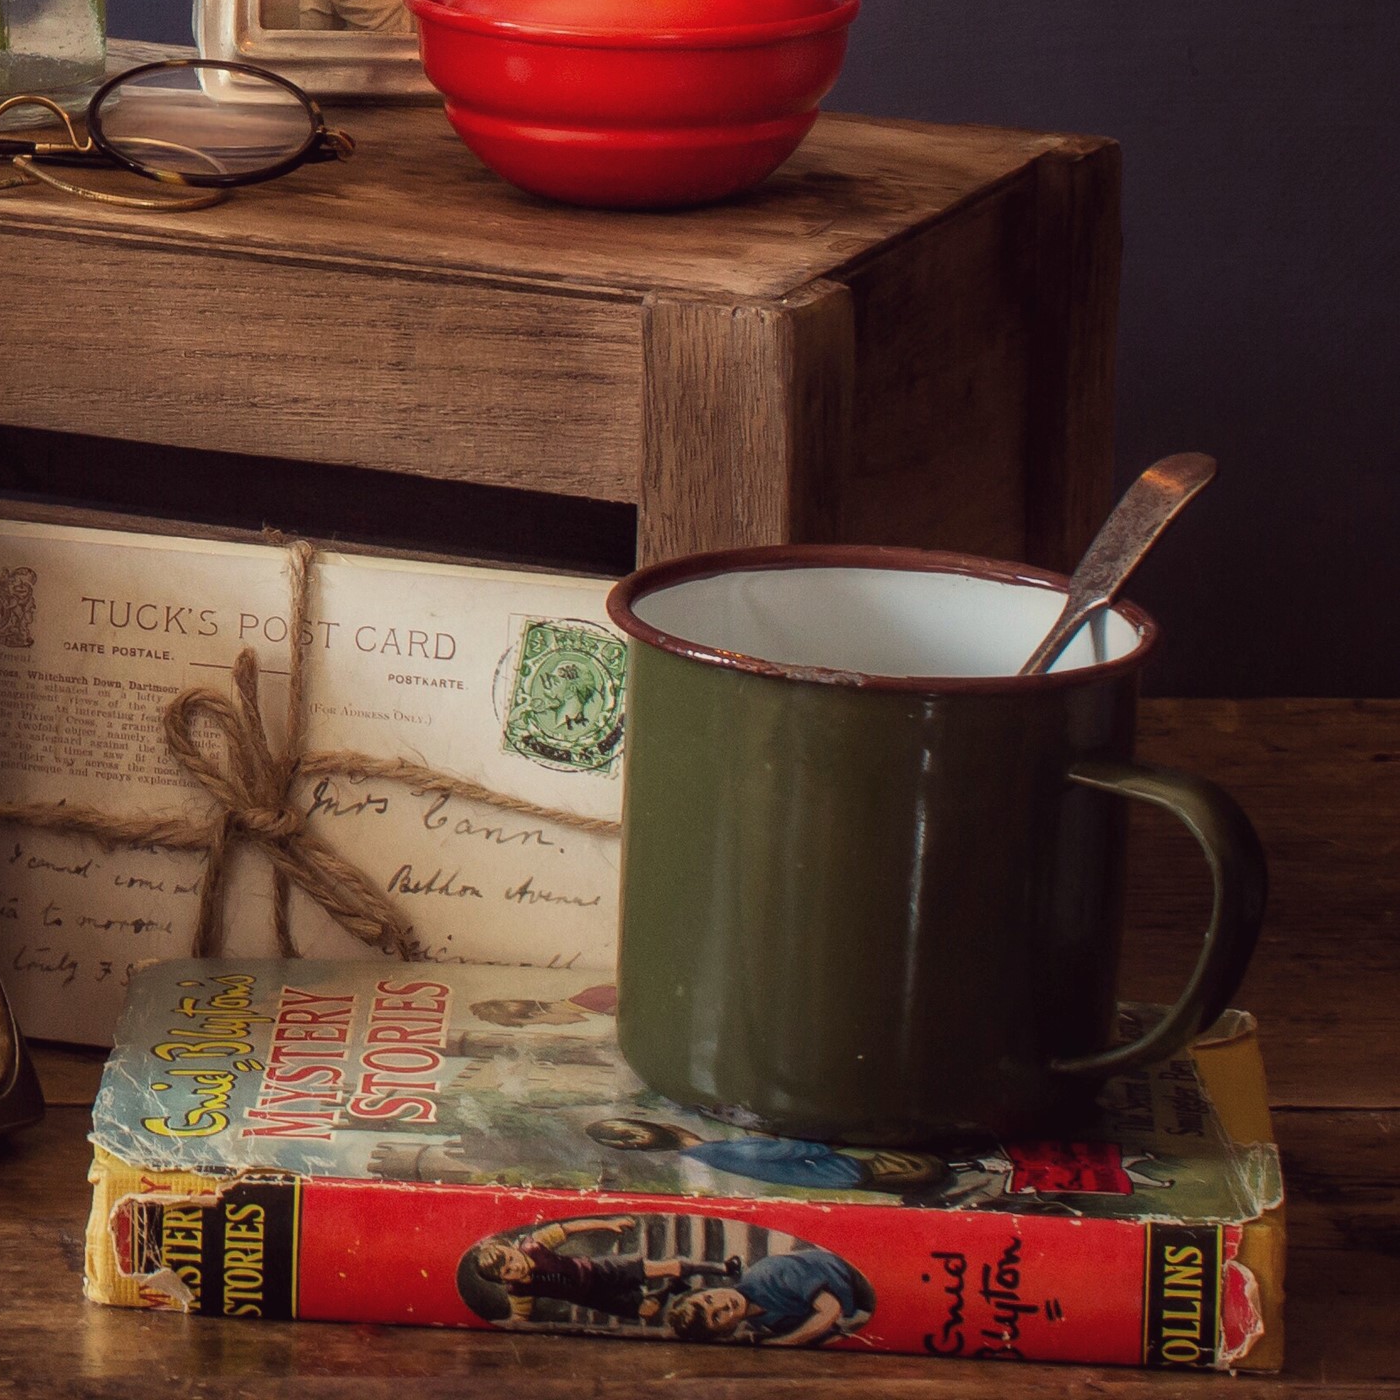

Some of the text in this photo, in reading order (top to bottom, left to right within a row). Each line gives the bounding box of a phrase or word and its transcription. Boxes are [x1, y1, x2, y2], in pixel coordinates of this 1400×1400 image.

[63, 641, 175, 661] CARTE POSTALE.
[81, 596, 457, 661] TUCK'S POST CARD
[27, 669, 87, 686] Whitchurch
[128, 679, 179, 695] Dartmoor
[141, 1067, 237, 1138] Enid
[240, 987, 355, 1141] MYSTERY
[348, 980, 451, 1123] STORIES
[223, 1203, 265, 1317] STORIES
[921, 1251, 967, 1357] Enid
[1161, 1246, 1203, 1365] OLLINS
